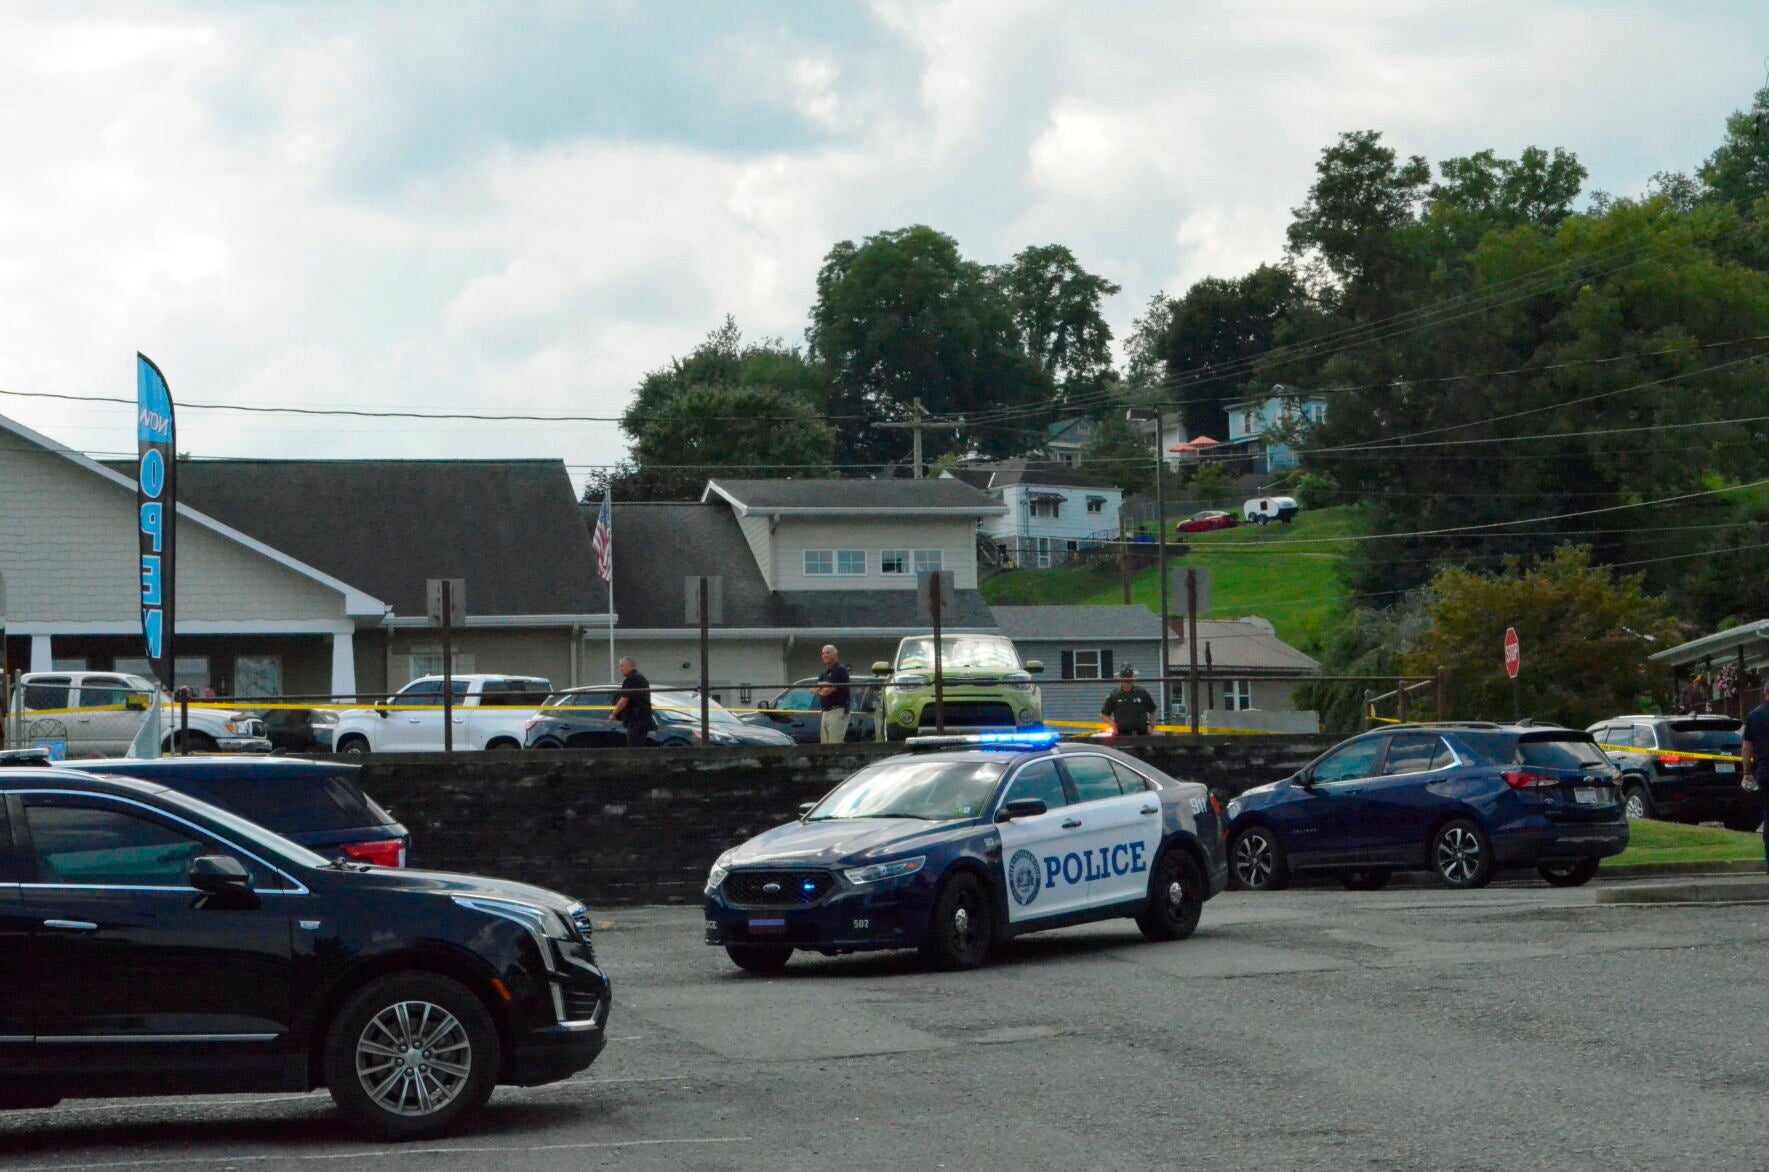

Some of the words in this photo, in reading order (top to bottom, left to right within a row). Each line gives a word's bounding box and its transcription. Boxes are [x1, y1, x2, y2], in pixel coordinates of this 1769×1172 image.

[1190, 798, 1208, 815] 911
[1043, 840, 1147, 889] POLICE
[853, 919, 869, 929] 502
